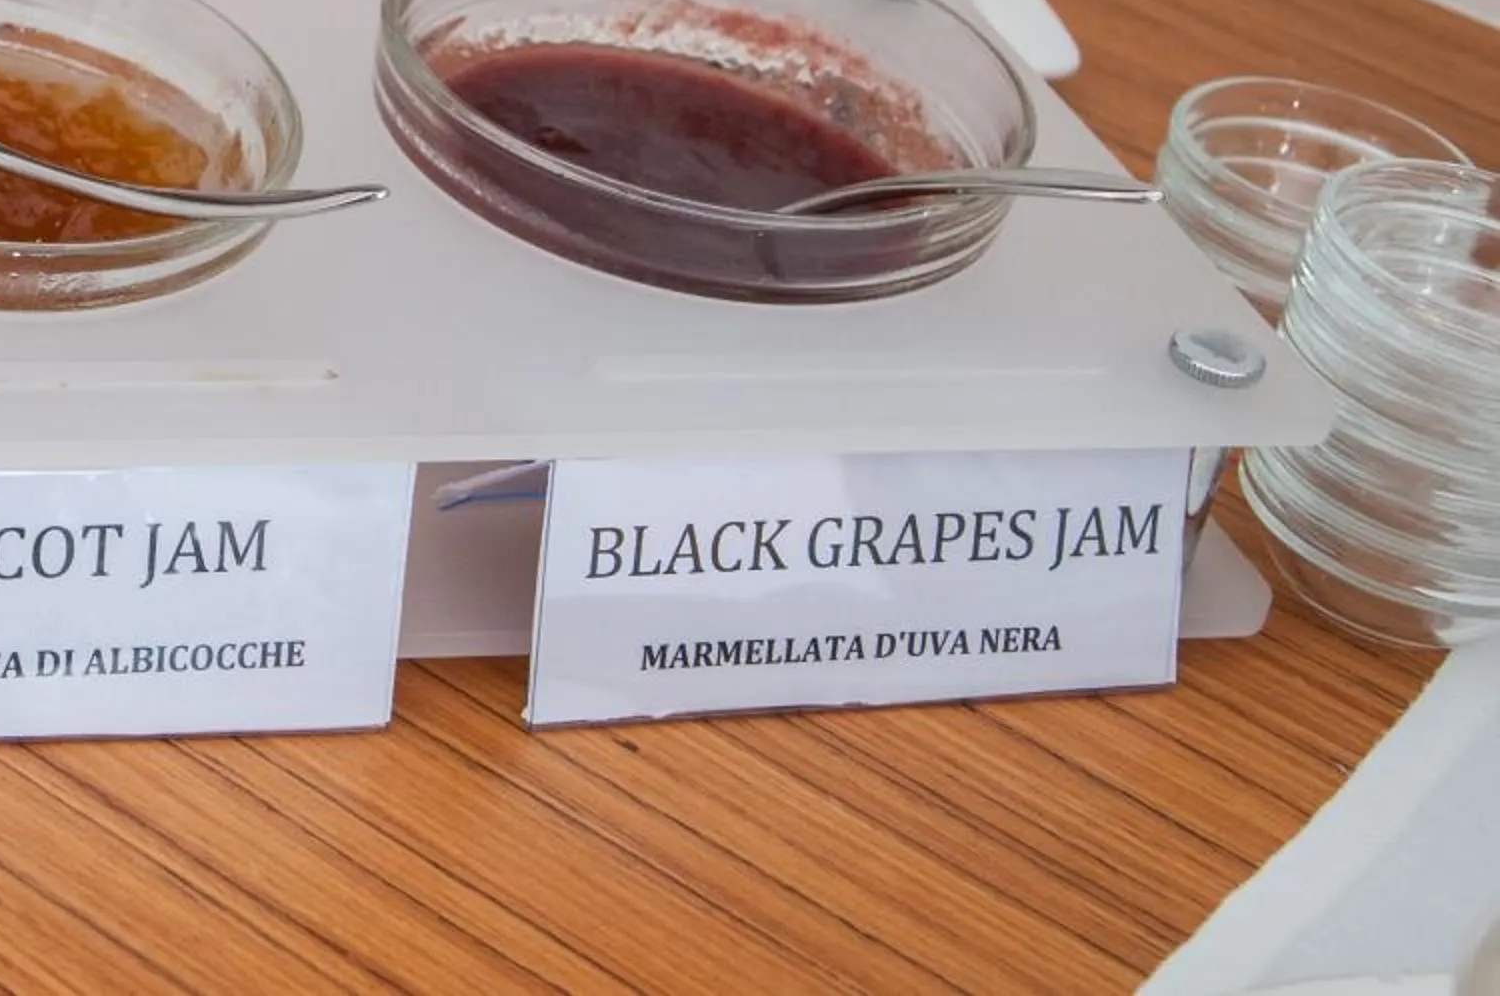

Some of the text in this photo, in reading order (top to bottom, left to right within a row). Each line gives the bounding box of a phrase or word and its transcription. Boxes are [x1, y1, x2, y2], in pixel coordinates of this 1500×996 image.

[138, 519, 272, 589] JAM
[584, 503, 1164, 580] BLACK GRAPES JAM
[35, 648, 76, 677] DI
[83, 639, 306, 676] ALBICOCCHE
[640, 624, 1063, 672] MARMELLATA D'UVA NERA
